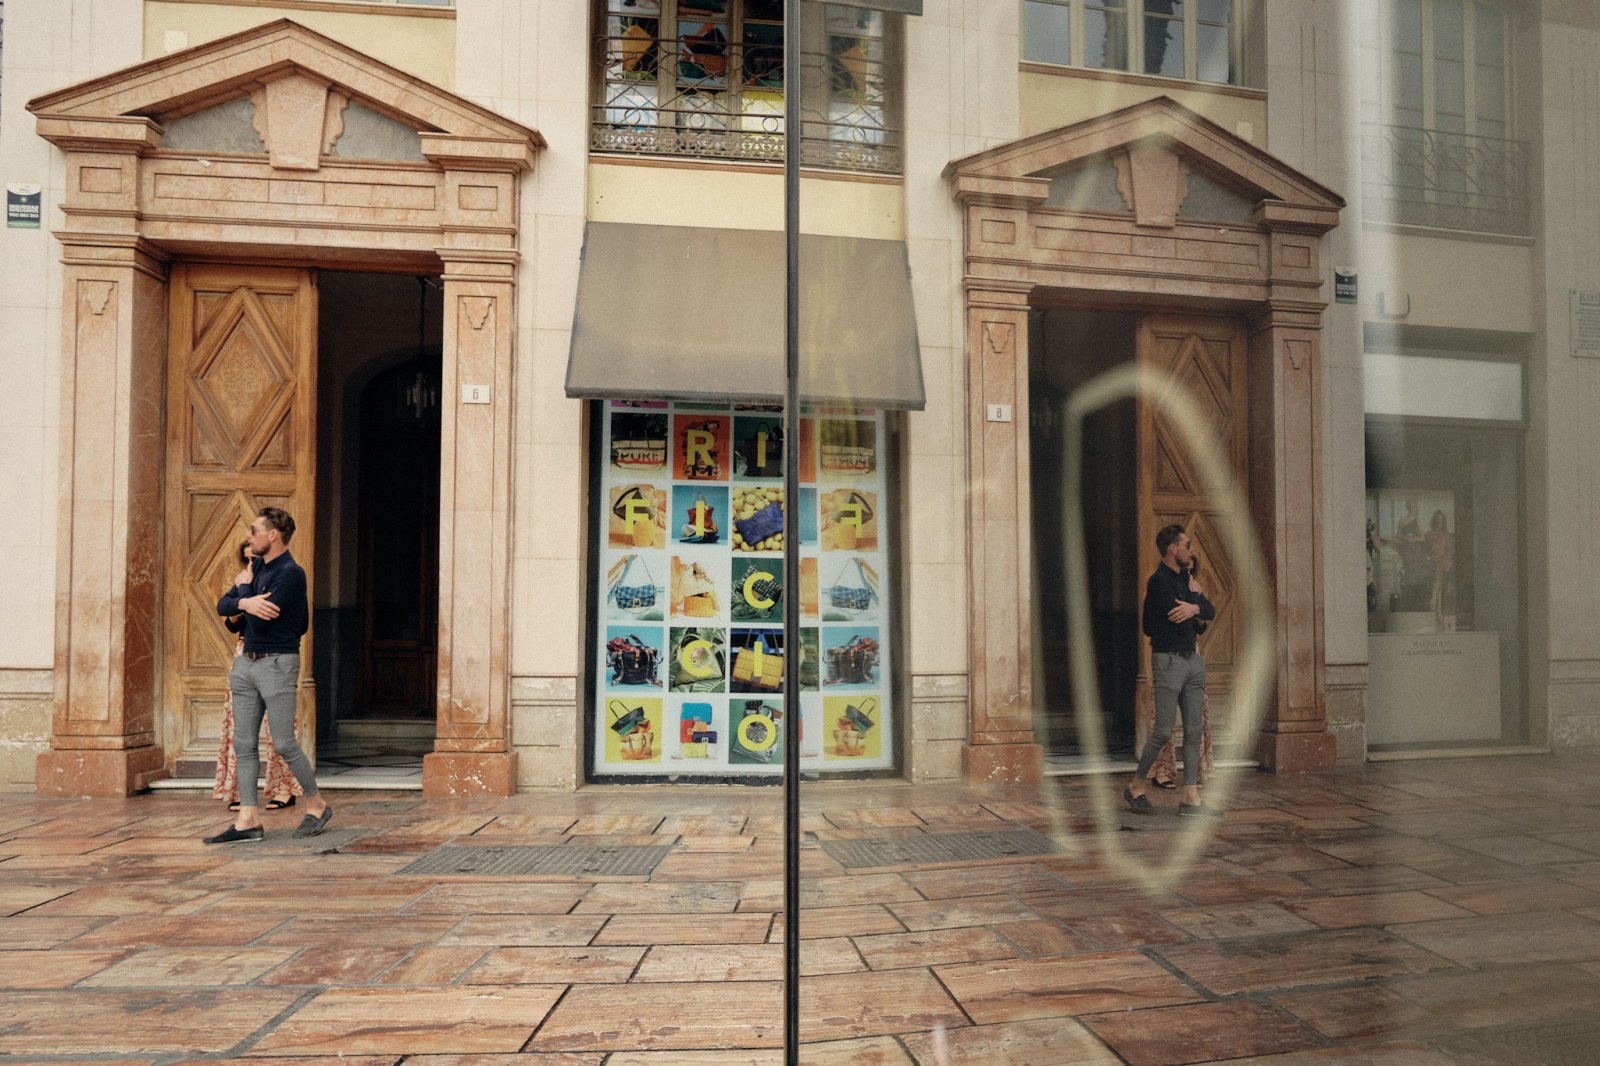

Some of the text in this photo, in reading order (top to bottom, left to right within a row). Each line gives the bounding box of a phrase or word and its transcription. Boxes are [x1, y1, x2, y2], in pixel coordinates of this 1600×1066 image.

[472, 388, 479, 400] 6
[686, 429, 767, 468] R I
[624, 499, 705, 536] F I
[743, 571, 776, 609] C
[681, 639, 763, 677] C I
[737, 714, 776, 751] O
